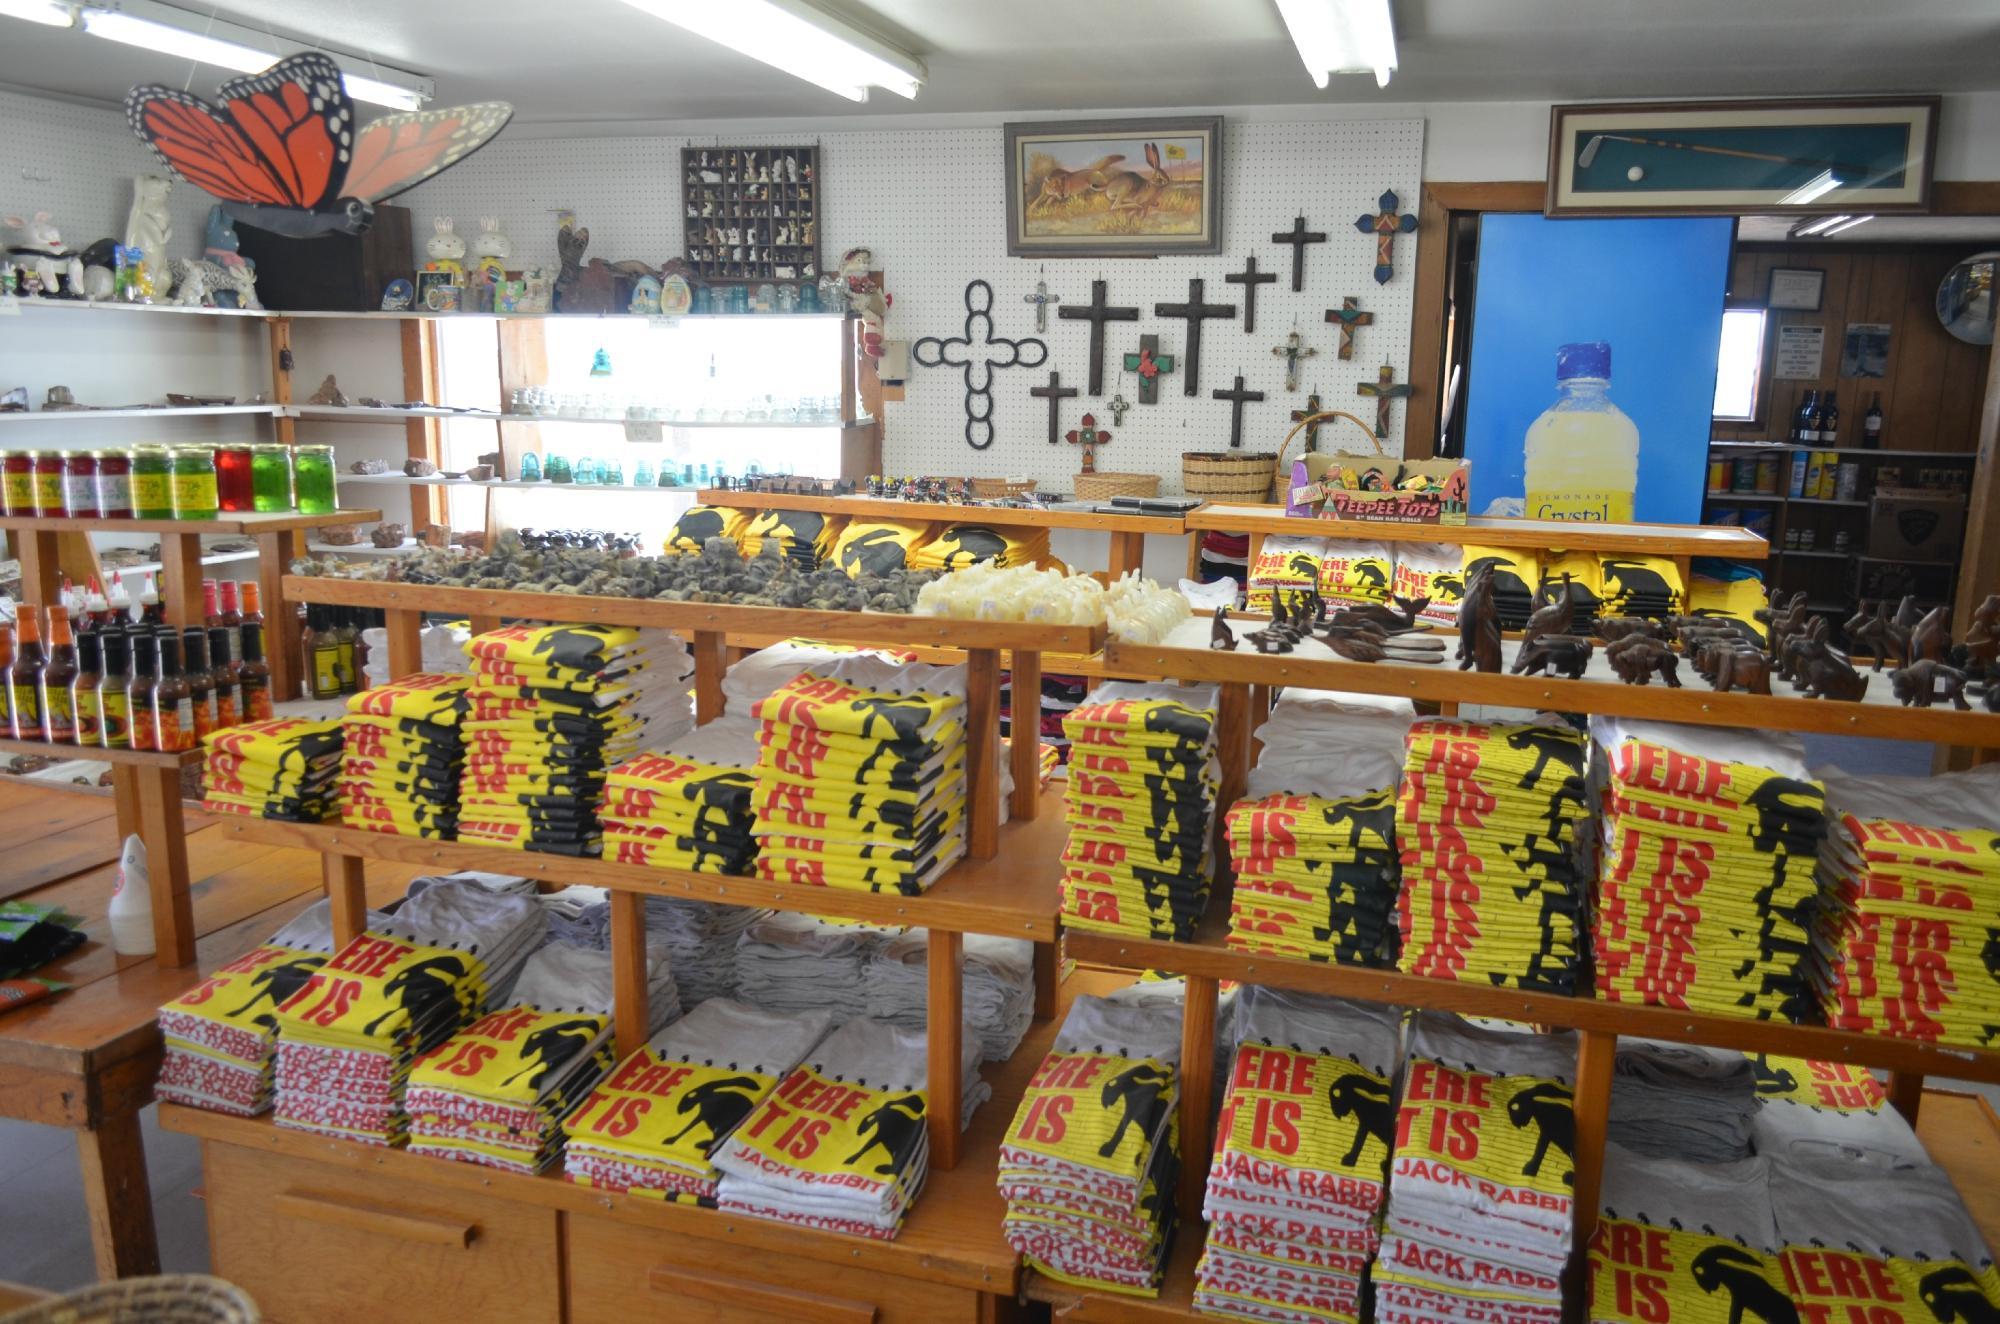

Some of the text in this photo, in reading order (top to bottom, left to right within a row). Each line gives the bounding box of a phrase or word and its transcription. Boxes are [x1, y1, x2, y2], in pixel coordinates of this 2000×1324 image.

[1335, 494, 1396, 516] TEEPEE
[1397, 497, 1441, 518] TOTS
[326, 934, 416, 979] ERE
[300, 977, 363, 1028] IS
[434, 1040, 499, 1077] IS
[607, 1048, 695, 1097] ERE
[1030, 1054, 1111, 1089] ERE
[1234, 1046, 1318, 1096] ERE
[1408, 1061, 1493, 1109] ERE
[591, 1097, 652, 1138] IS
[773, 1116, 832, 1160] IS
[1017, 1094, 1075, 1145] IS
[1250, 1097, 1302, 1156] IS
[1428, 1106, 1481, 1162] IS
[733, 1147, 794, 1177] JACK
[796, 1170, 887, 1194] RABBIT
[1394, 1158, 1573, 1216] JACK RABBI
[1614, 1268, 1671, 1324] IS
